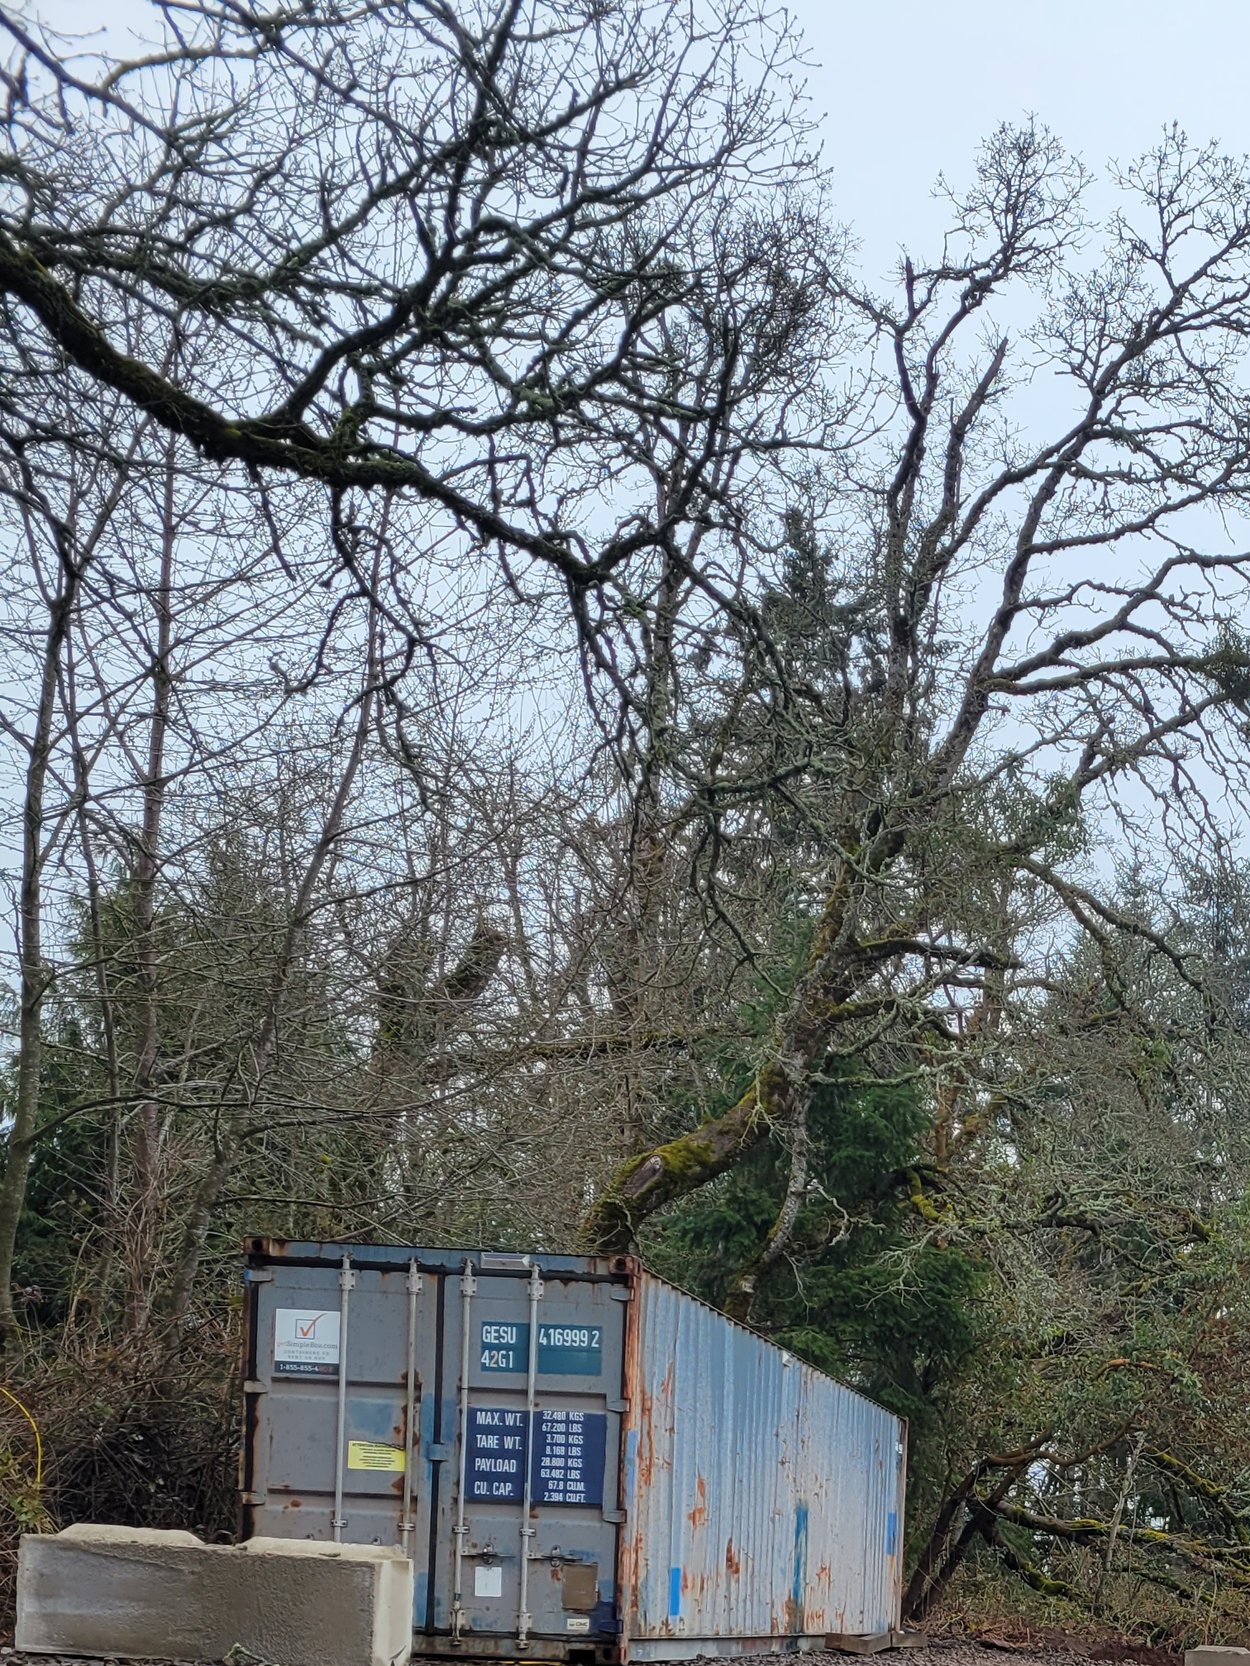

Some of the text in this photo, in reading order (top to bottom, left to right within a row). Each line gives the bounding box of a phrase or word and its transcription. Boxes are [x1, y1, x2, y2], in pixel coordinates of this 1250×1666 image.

[482, 1326, 600, 1347] GESU 416999 2
[277, 1340, 338, 1349] SimpleBox.com
[481, 1350, 513, 1368] 42G1
[476, 1411, 584, 1426] MAX. WT. 32.480 KGS
[542, 1423, 582, 1433] 67.200 LBS
[476, 1434, 584, 1450] TARE WT. 3.700 KGS
[568, 1446, 581, 1456] LBS
[474, 1457, 583, 1473] PAYLOAD 28.800 KGS
[540, 1469, 580, 1479] 63.482 LBS
[474, 1481, 490, 1495] CU.
[492, 1482, 514, 1496] CAP.
[548, 1480, 564, 1490] 67.8
[543, 1492, 563, 1503] 2.394
